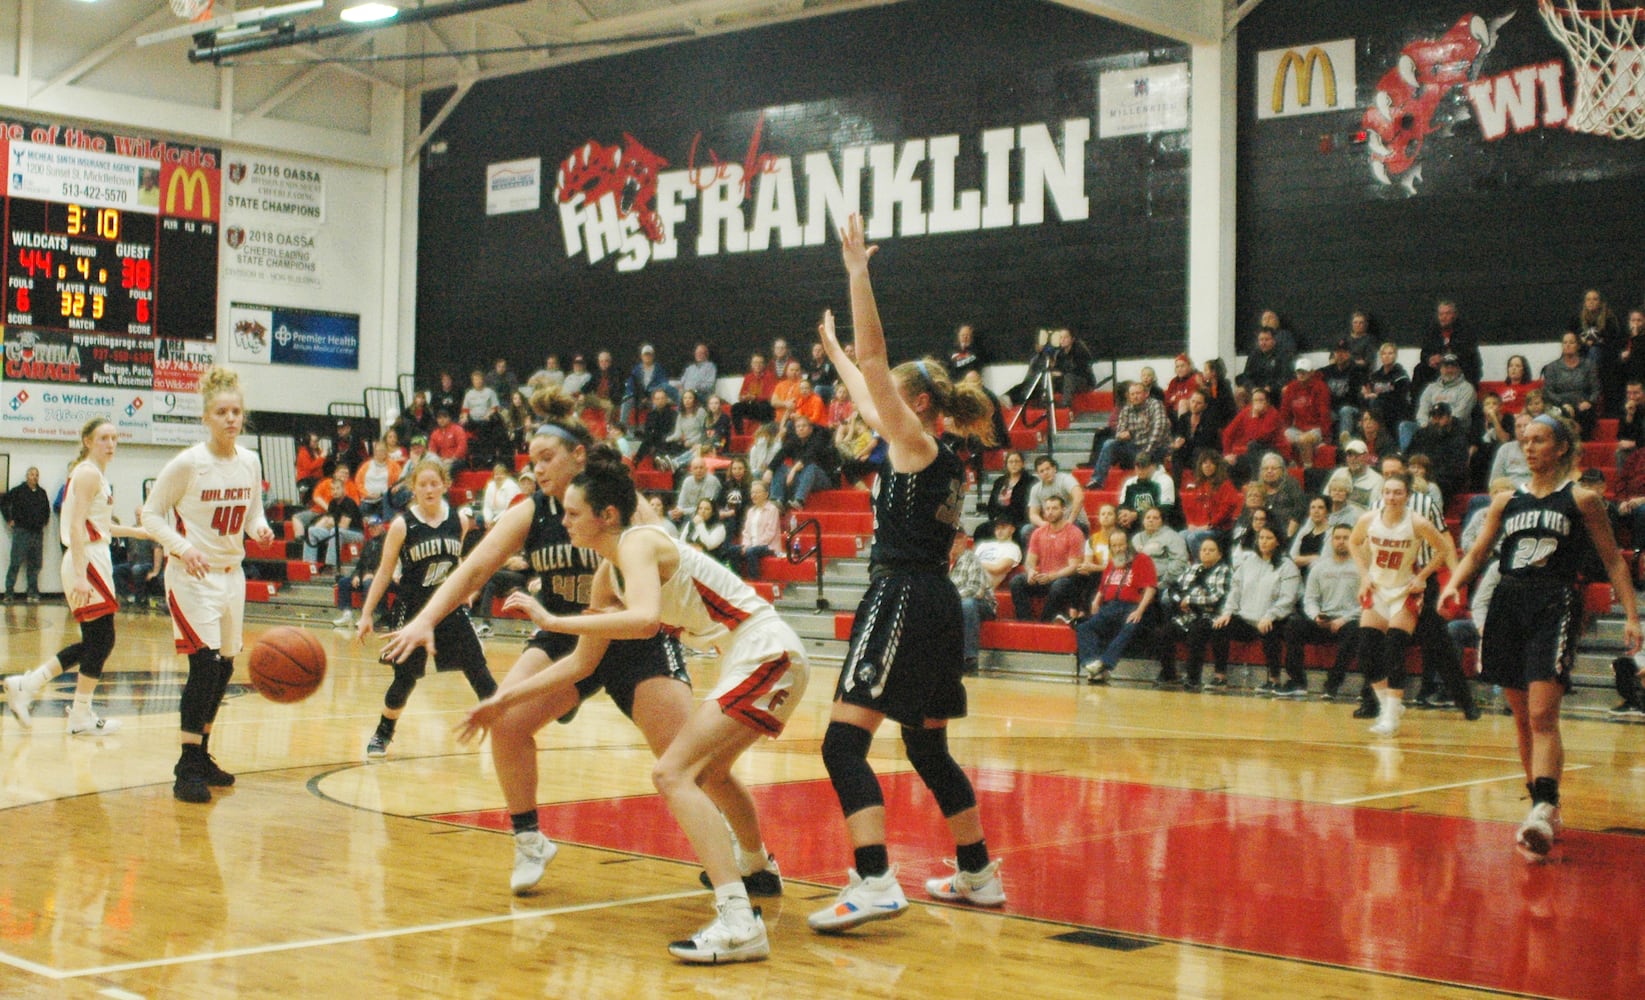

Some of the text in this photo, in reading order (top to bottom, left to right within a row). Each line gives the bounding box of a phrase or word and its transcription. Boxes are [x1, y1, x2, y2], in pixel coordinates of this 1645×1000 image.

[31, 124, 60, 146] of
[65, 128, 107, 153] the
[113, 135, 217, 168] Wildcats
[283, 168, 320, 183] OASSA
[62, 182, 127, 203] 513-422-5570
[652, 117, 1091, 262] FRANKLIN
[228, 195, 321, 218] STATE CHAMPIONS
[12, 230, 68, 251] WILDCATS
[248, 229, 315, 248] 2018 OASSA
[557, 190, 653, 272] FHS
[69, 244, 97, 257] PERIOD
[116, 243, 151, 259] GUEST
[19, 248, 53, 279] 44
[76, 256, 90, 280] 4
[121, 257, 152, 291] 38
[237, 255, 316, 273] STATE CHAMPIONS
[9, 276, 34, 290] FOULS
[56, 282, 108, 297] PLAYER FOUL
[16, 287, 31, 313] 6
[61, 291, 85, 318] 32
[129, 289, 153, 301] FOULS
[92, 294, 105, 320] 3
[136, 297, 150, 324] 6
[7, 313, 33, 325] SCORE
[68, 319, 95, 330] MATCH
[127, 324, 151, 335] SCORE
[73, 333, 154, 350] mygorillagarage.com
[293, 331, 357, 348] Premier Health
[93, 371, 116, 386] Porch,
[103, 363, 132, 376] Garage,
[42, 392, 115, 407] Go Wildcats!
[211, 505, 247, 537] 40
[410, 538, 442, 563] VALLEY
[531, 544, 573, 573] VALLEY
[1376, 549, 1404, 570] 20
[1512, 537, 1558, 569] 20
